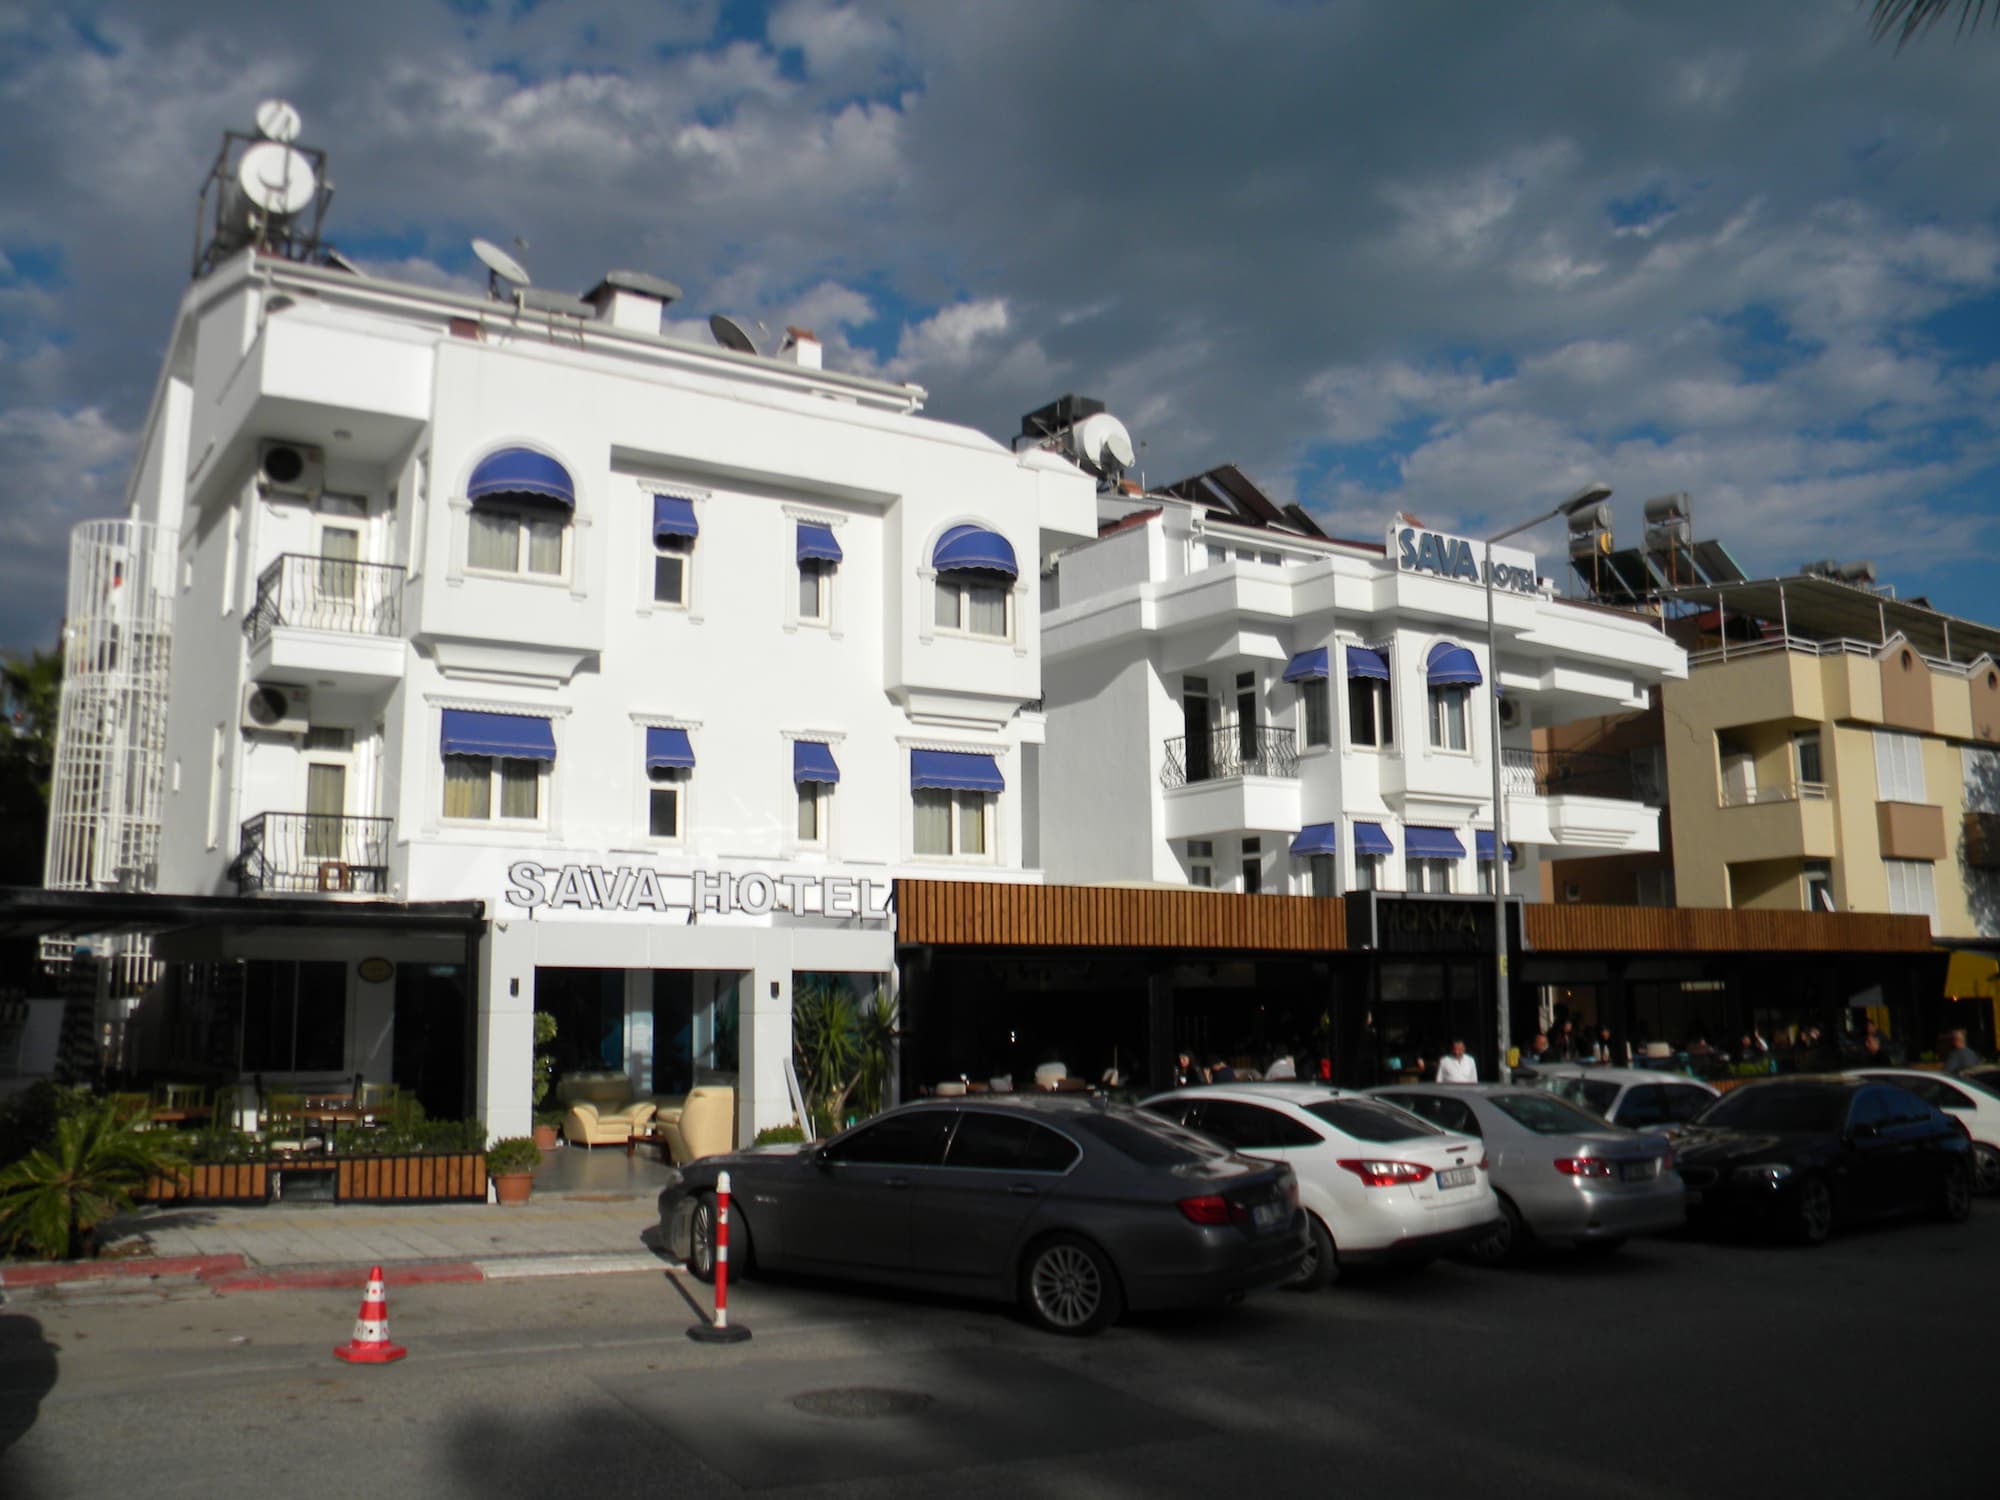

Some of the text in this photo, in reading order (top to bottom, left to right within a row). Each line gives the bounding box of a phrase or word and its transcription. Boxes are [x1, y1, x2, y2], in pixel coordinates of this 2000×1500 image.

[1399, 528, 1537, 593] SAVA HOTEL
[506, 861, 888, 919] SAVA HOTEL
